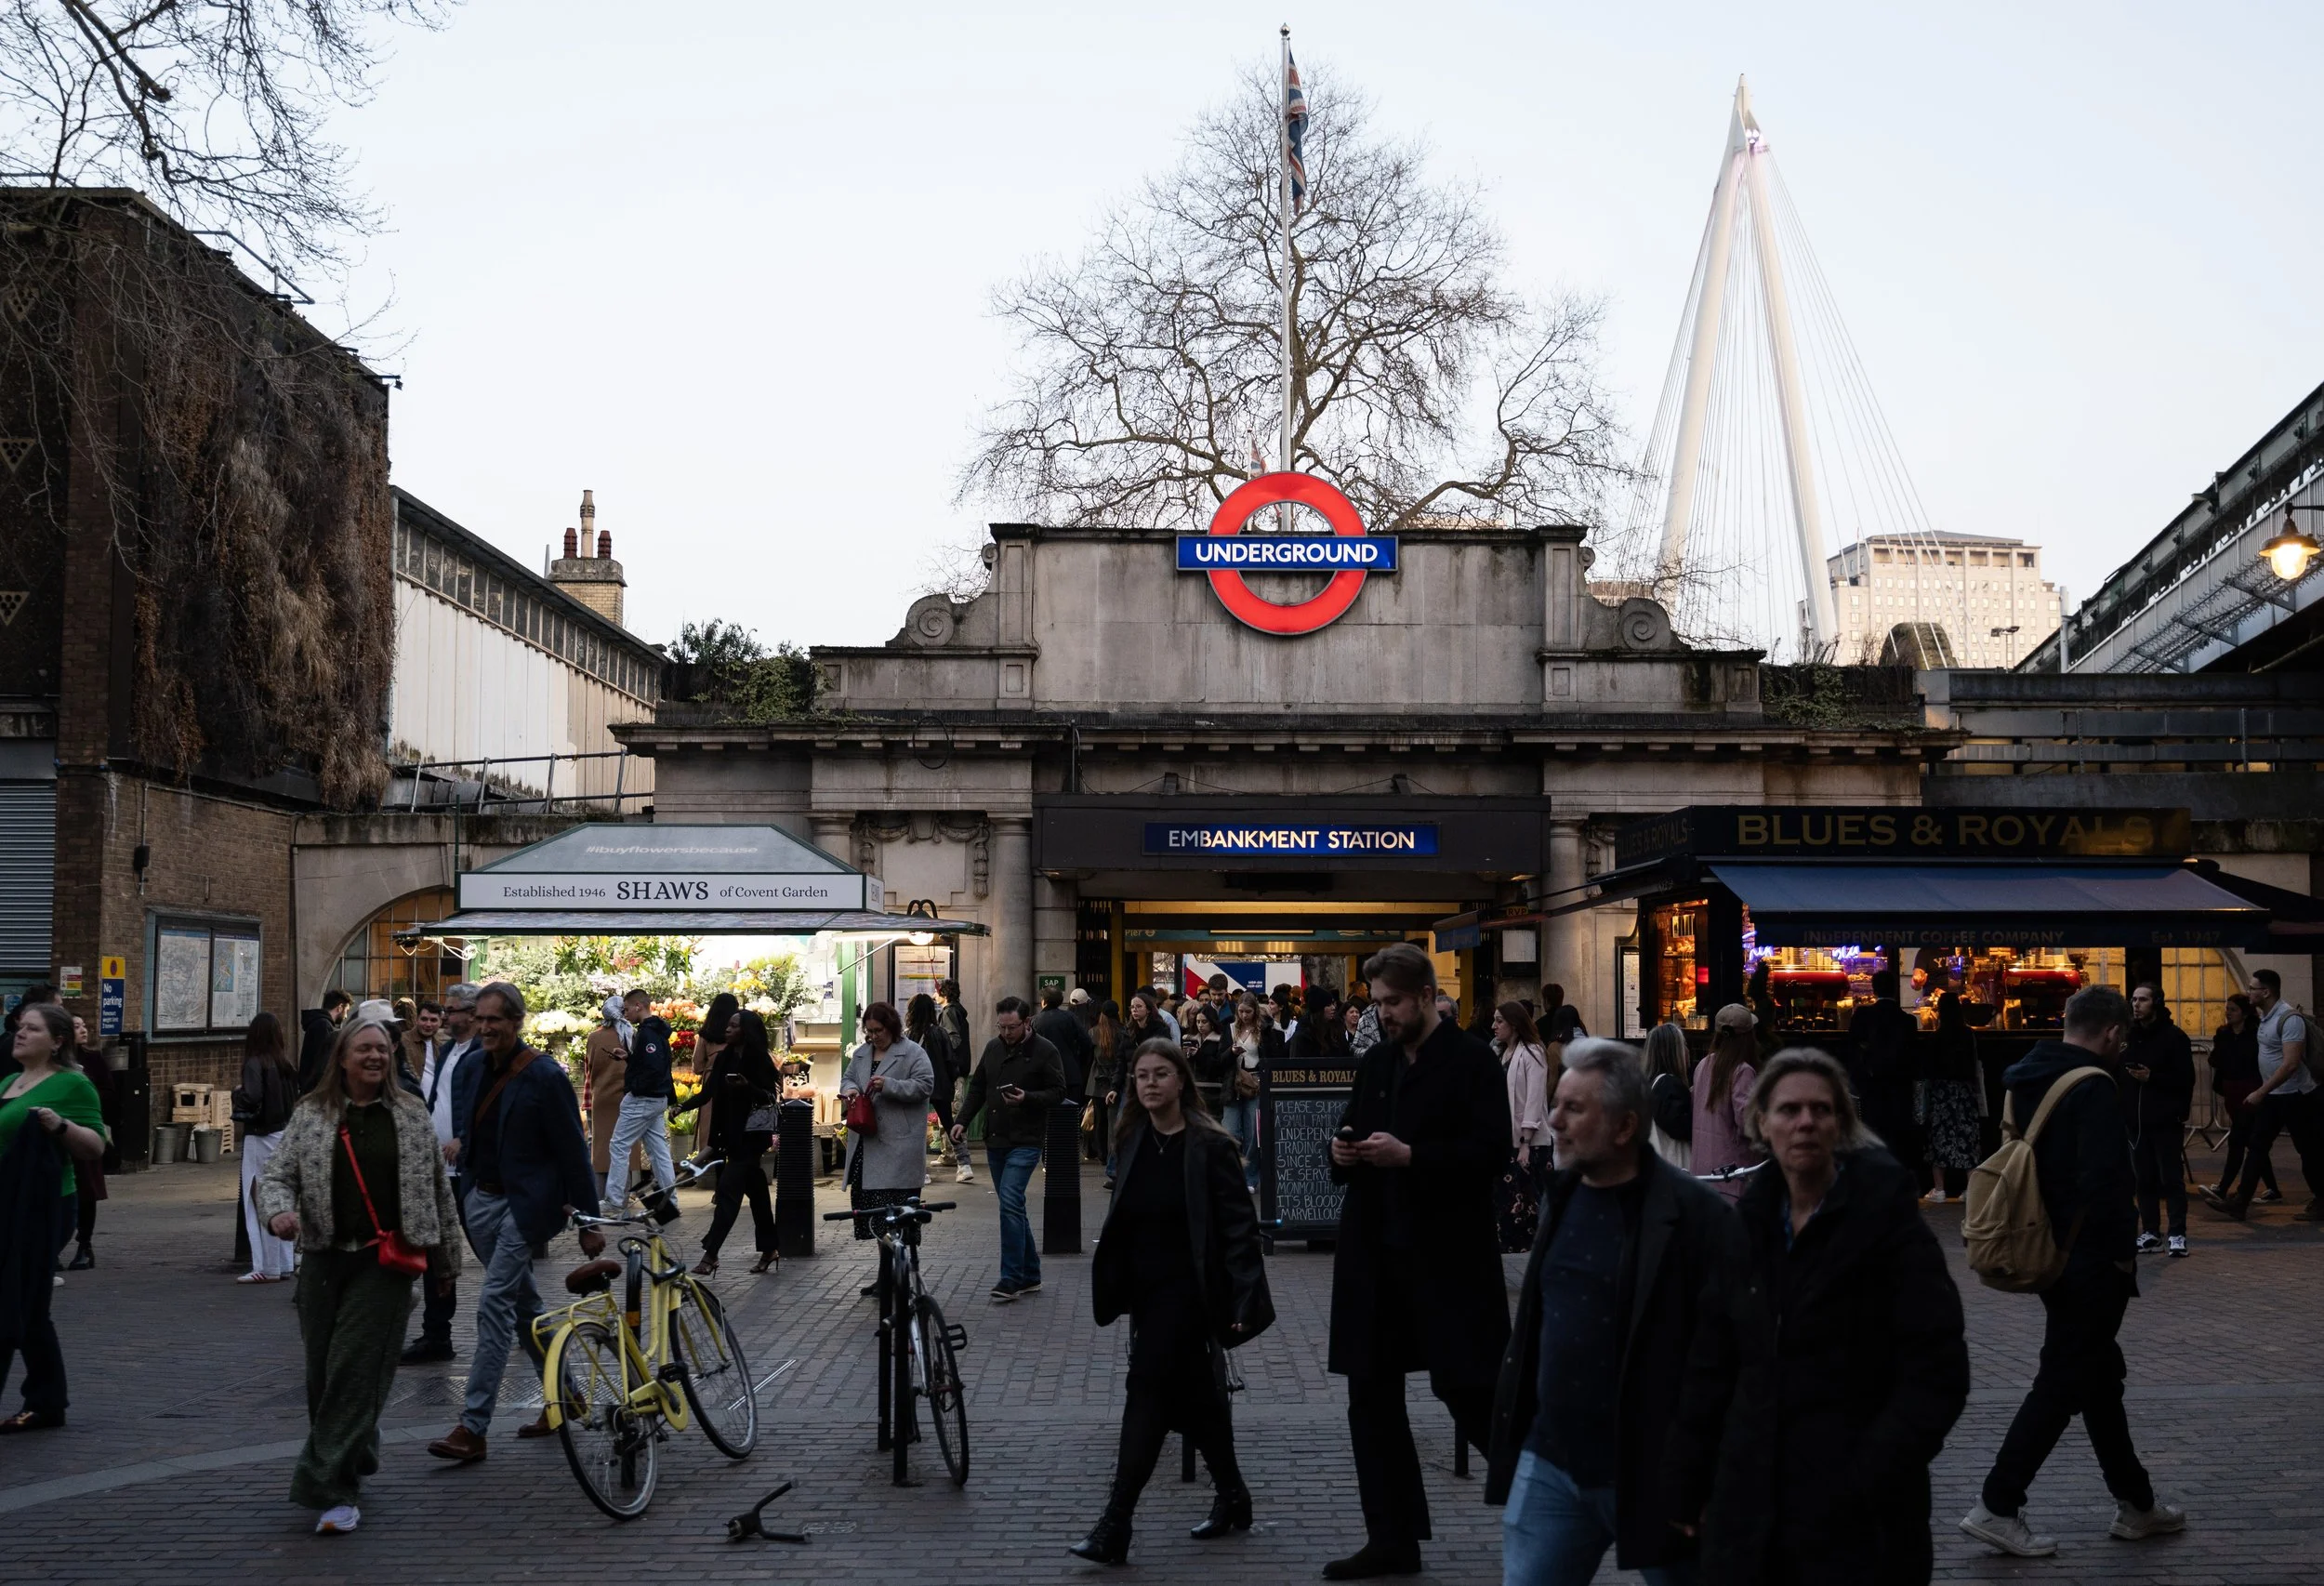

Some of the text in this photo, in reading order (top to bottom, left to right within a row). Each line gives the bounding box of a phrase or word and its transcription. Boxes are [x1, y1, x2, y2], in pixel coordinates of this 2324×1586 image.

[1195, 543, 1379, 562] UNDERGROUND
[1651, 818, 1688, 851] ROYALS
[1736, 814, 2154, 848] BLUES & ROYALS
[1169, 829, 1415, 850] EMBANKMENT STATION
[586, 846, 759, 855] #ibuyflowersbecause
[503, 880, 828, 901] Established 1946 SHAWS of Covent Garden
[1508, 907, 1526, 916] RVP
[1803, 931, 2065, 944] INDEPENDENT COFFEE COMPANY
[103, 983, 112, 993] No
[103, 996, 123, 1008] parking
[1271, 1070, 1306, 1083] BLUES
[1308, 1069, 1317, 1083] &
[1274, 1100, 1349, 1114] PLEASE SUPPO
[1274, 1114, 1340, 1128] A SMALL FAMILY
[1278, 1127, 1340, 1141] INDEPEND
[1274, 1141, 1322, 1154] TRADING
[1276, 1155, 1313, 1168] SINCE
[1276, 1168, 1332, 1181] WE SERVE
[1276, 1181, 1329, 1195] MONMOUTH
[1276, 1195, 1345, 1208] ITS BLOODY
[1280, 1208, 1343, 1221] MARVELLOUS
